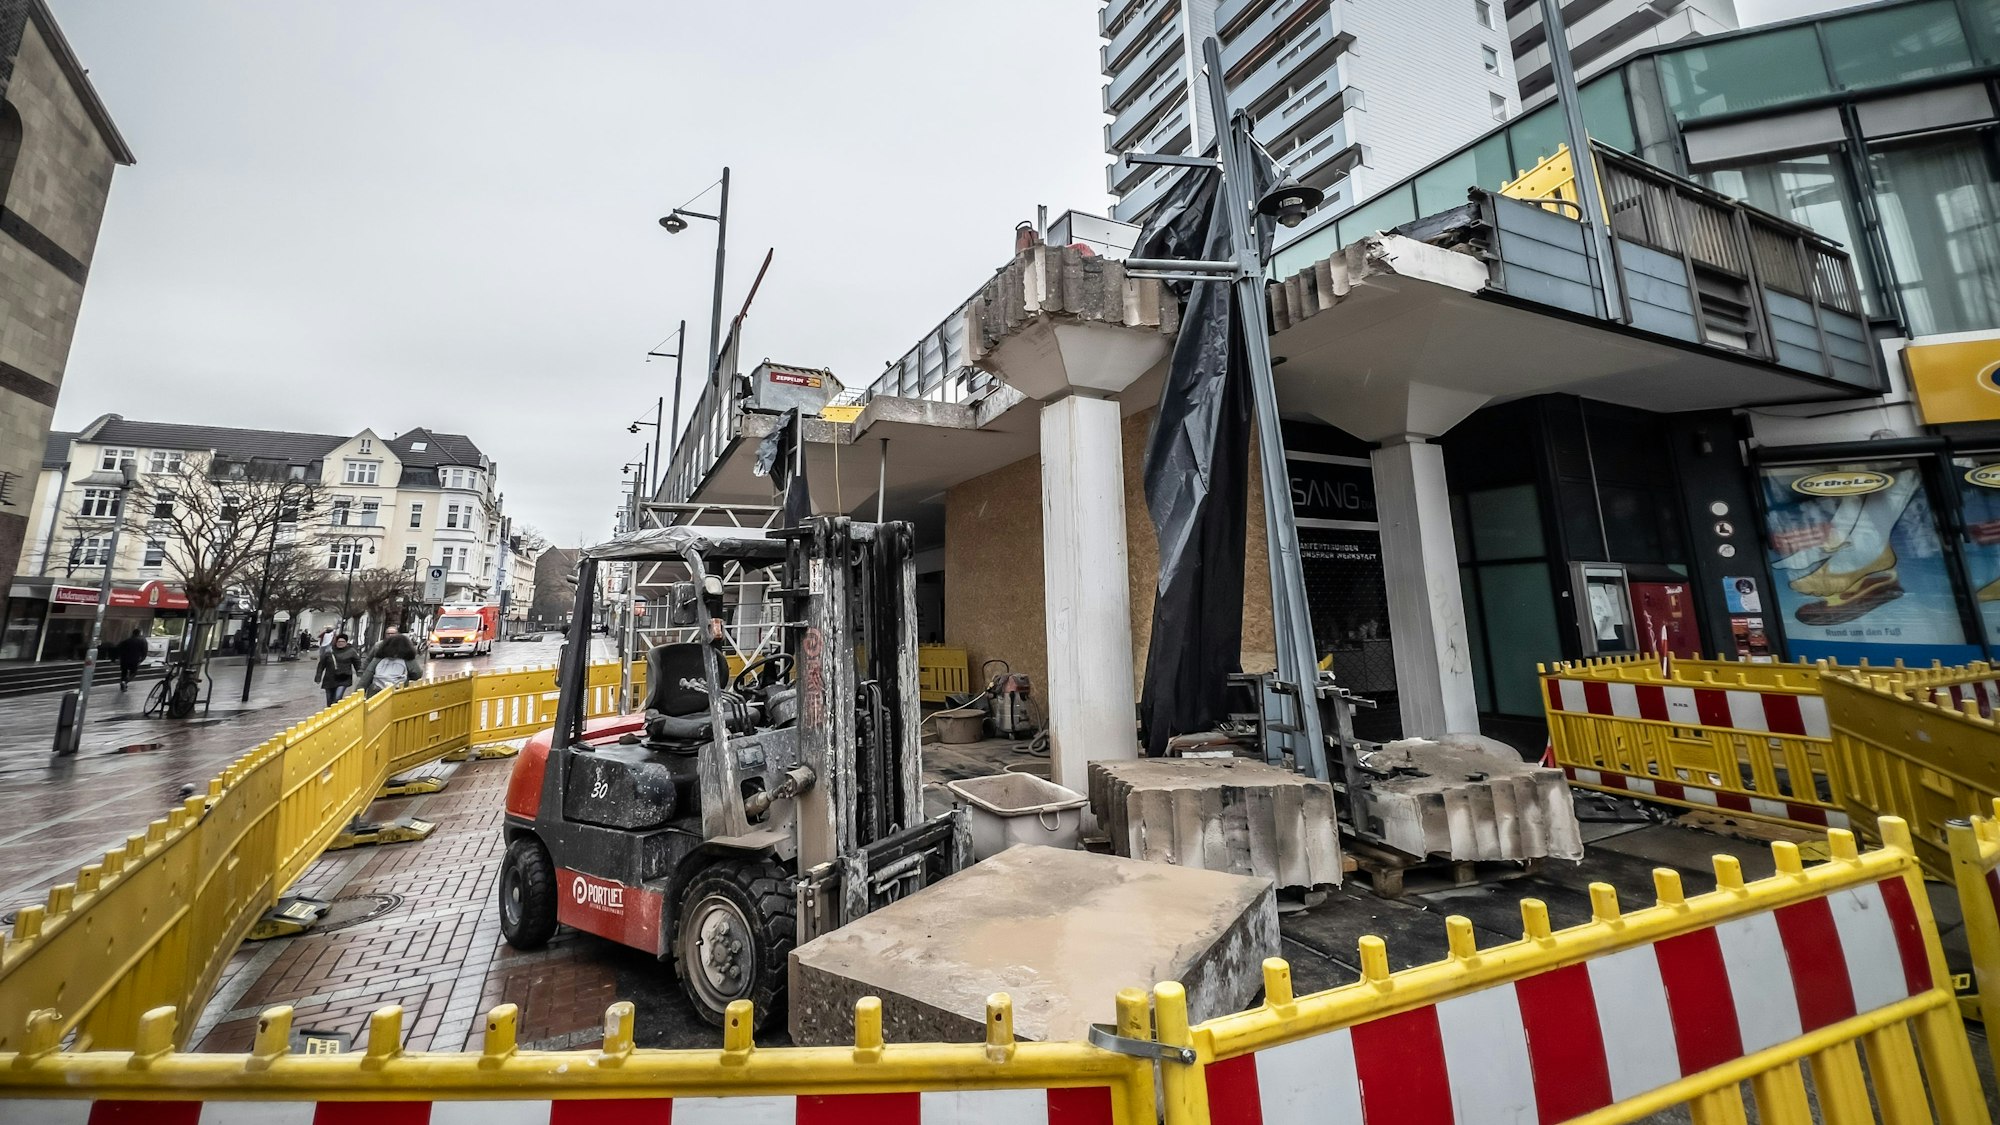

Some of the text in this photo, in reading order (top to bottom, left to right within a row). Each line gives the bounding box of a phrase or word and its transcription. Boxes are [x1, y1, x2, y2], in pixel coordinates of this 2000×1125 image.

[776, 375, 804, 383] ZEPPELIN
[1291, 477, 1360, 510] SANG
[591, 782, 608, 799] 30
[588, 883, 624, 908] PORTLIFT
